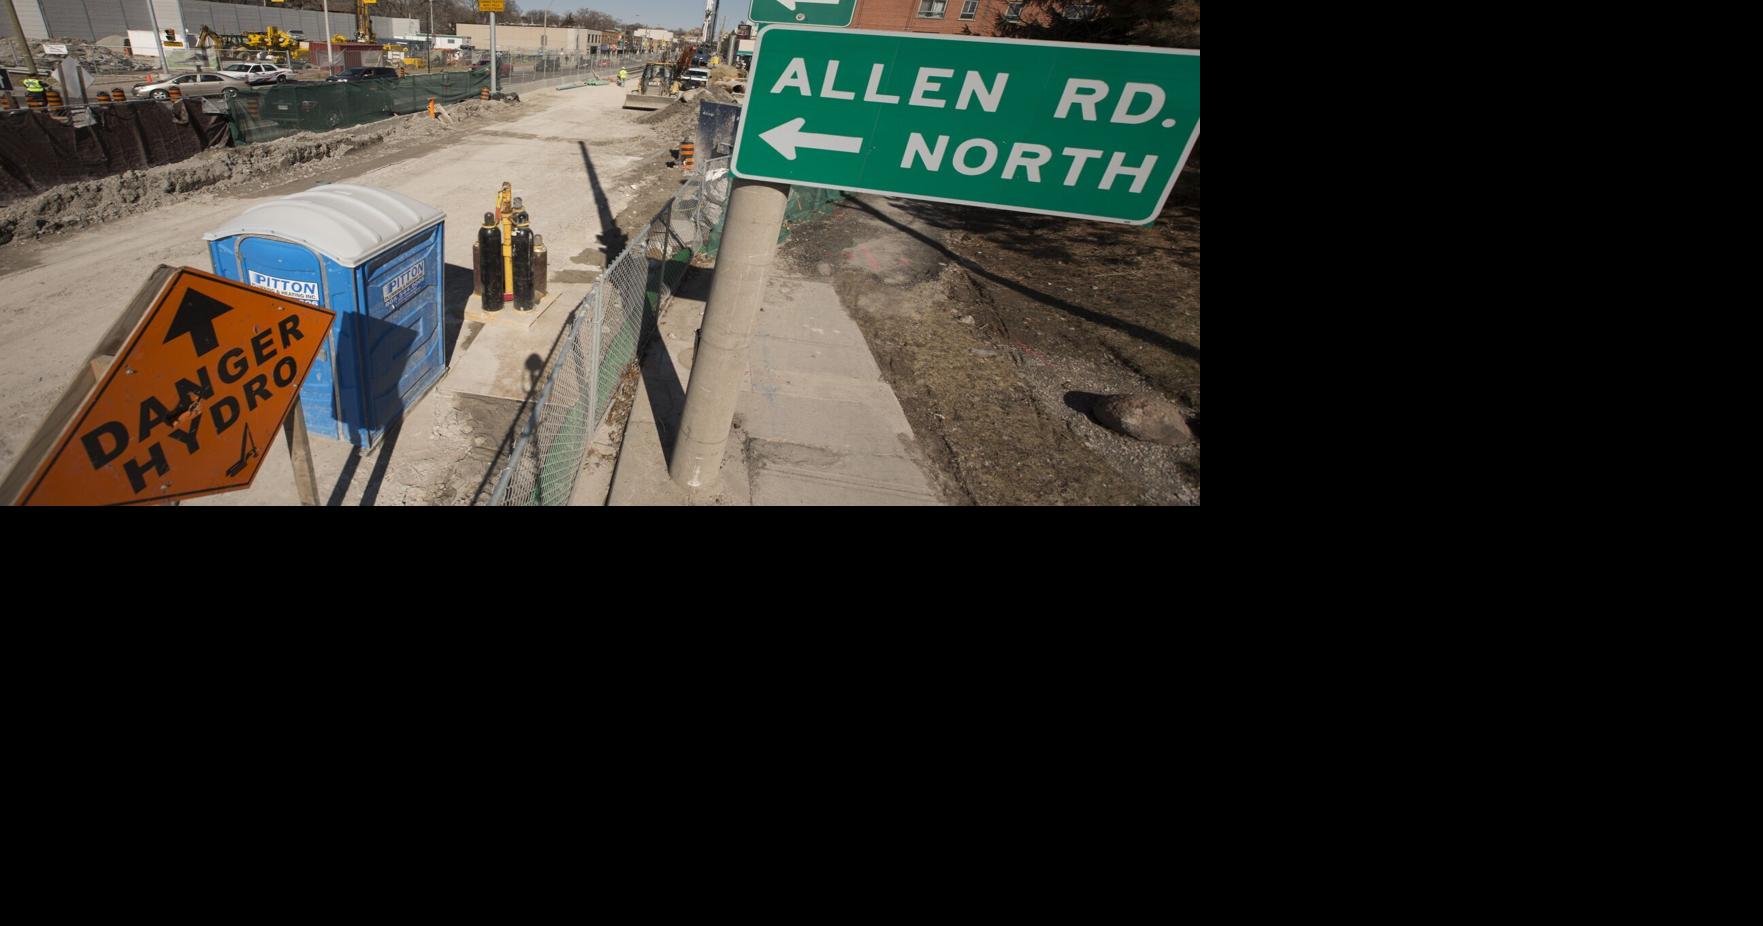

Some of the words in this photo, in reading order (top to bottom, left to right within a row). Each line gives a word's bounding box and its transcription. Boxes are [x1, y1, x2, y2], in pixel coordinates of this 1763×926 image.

[770, 57, 1009, 113] ALLEN
[1053, 77, 1177, 129] RD.
[900, 132, 1158, 194] NORTH
[255, 274, 316, 294] PITTON
[387, 260, 424, 293] PITTON
[80, 314, 304, 471] DANGER
[123, 356, 297, 494] HYDRO
